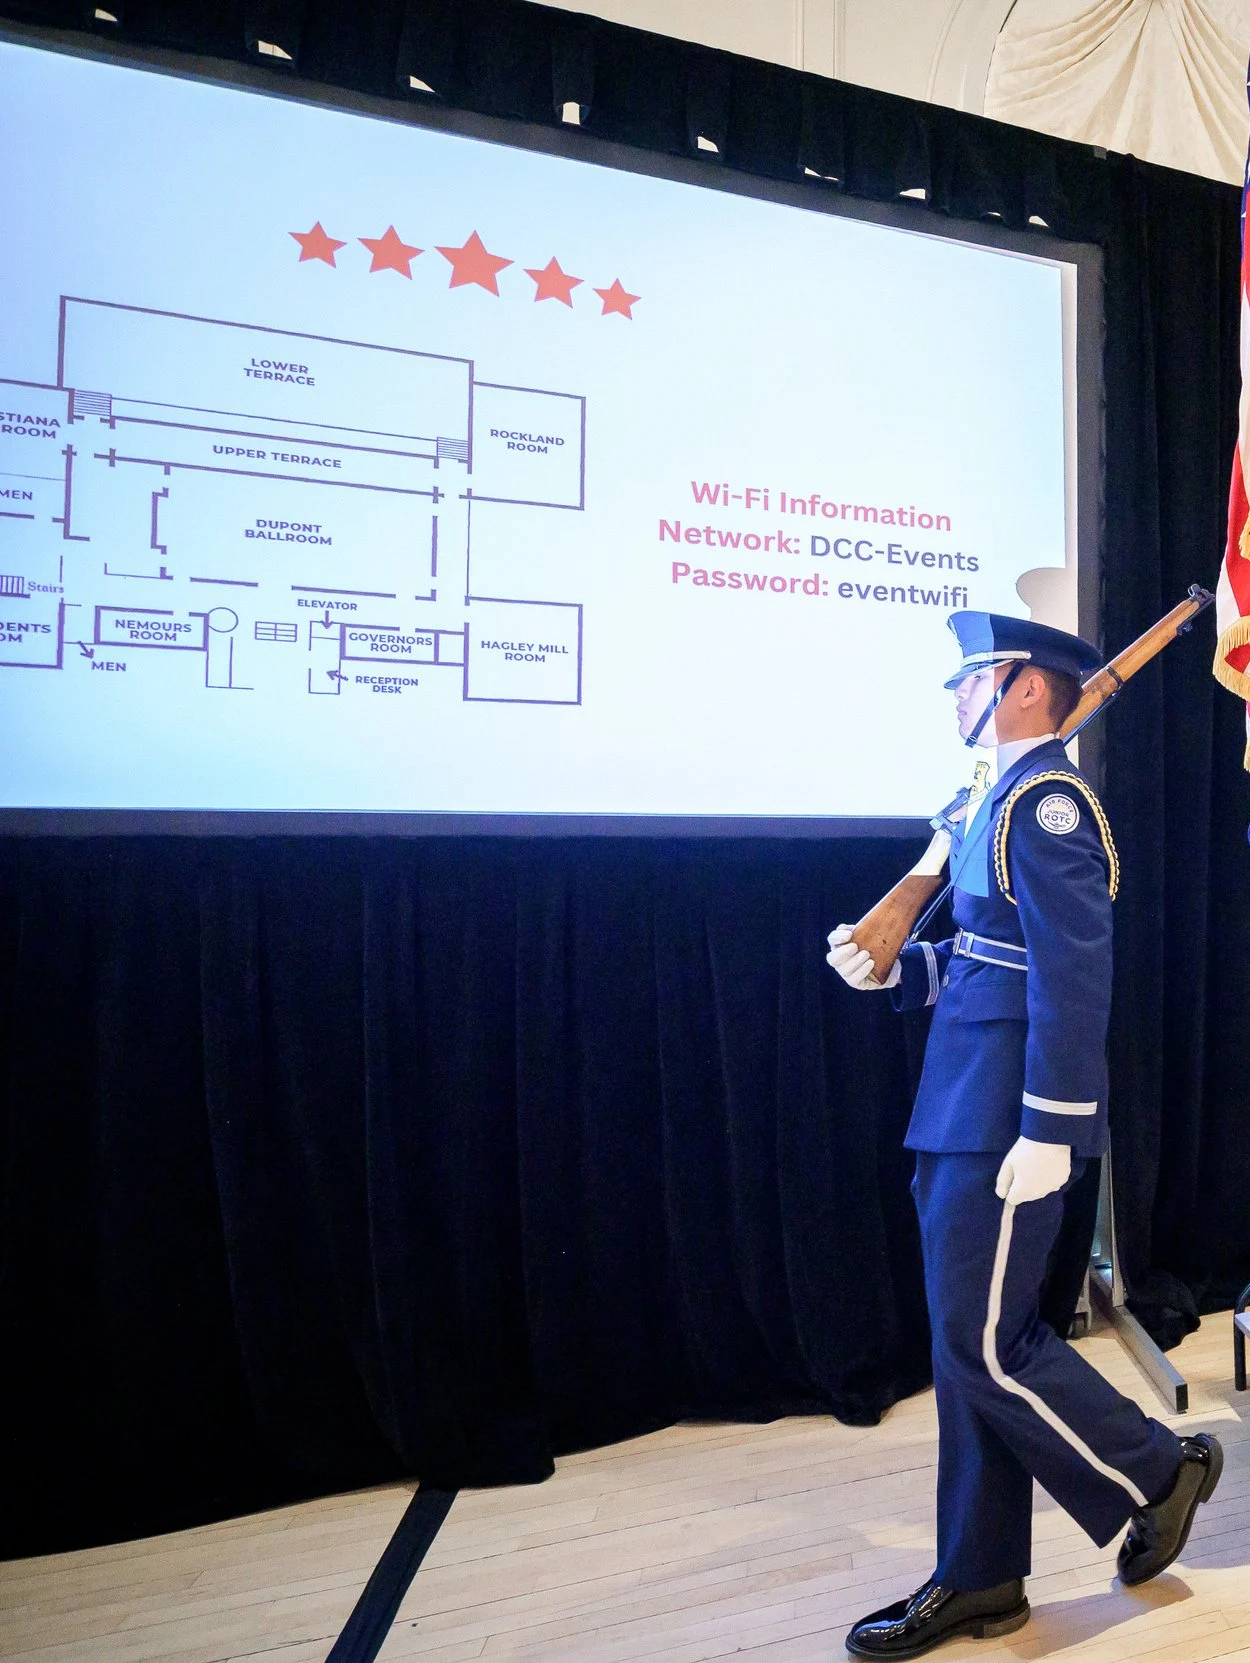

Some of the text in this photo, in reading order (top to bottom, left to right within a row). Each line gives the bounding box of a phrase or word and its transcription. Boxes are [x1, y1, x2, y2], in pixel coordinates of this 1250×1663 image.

[251, 358, 309, 374] LOWER
[243, 368, 315, 386] TERRACE
[1, 424, 56, 439] ROOM
[490, 429, 565, 446] ROCKLAND
[507, 441, 548, 454] ROOM
[212, 445, 342, 468] UPPER TERRACE
[690, 480, 952, 532] Wi-Fi Information
[256, 519, 322, 533] DUPONT
[244, 529, 332, 546] BALLROOM
[658, 519, 980, 572] Network: DCC-Events
[28, 581, 65, 594] Stairs
[672, 561, 968, 608] Password: eventwifi
[297, 598, 358, 611] ELEVATOR
[114, 619, 192, 634] NEMOURS
[130, 630, 178, 642] ROOM
[348, 632, 434, 646] GOVERNORS
[370, 642, 412, 654] ROOM
[481, 640, 569, 654] HAGLEY MILL
[504, 652, 546, 663] ROOM
[91, 661, 127, 672] MEN
[355, 675, 419, 686] RECEPTION
[372, 684, 402, 694] DESK
[1058, 799, 1074, 812] FORCE
[1044, 814, 1071, 824] ROTC
